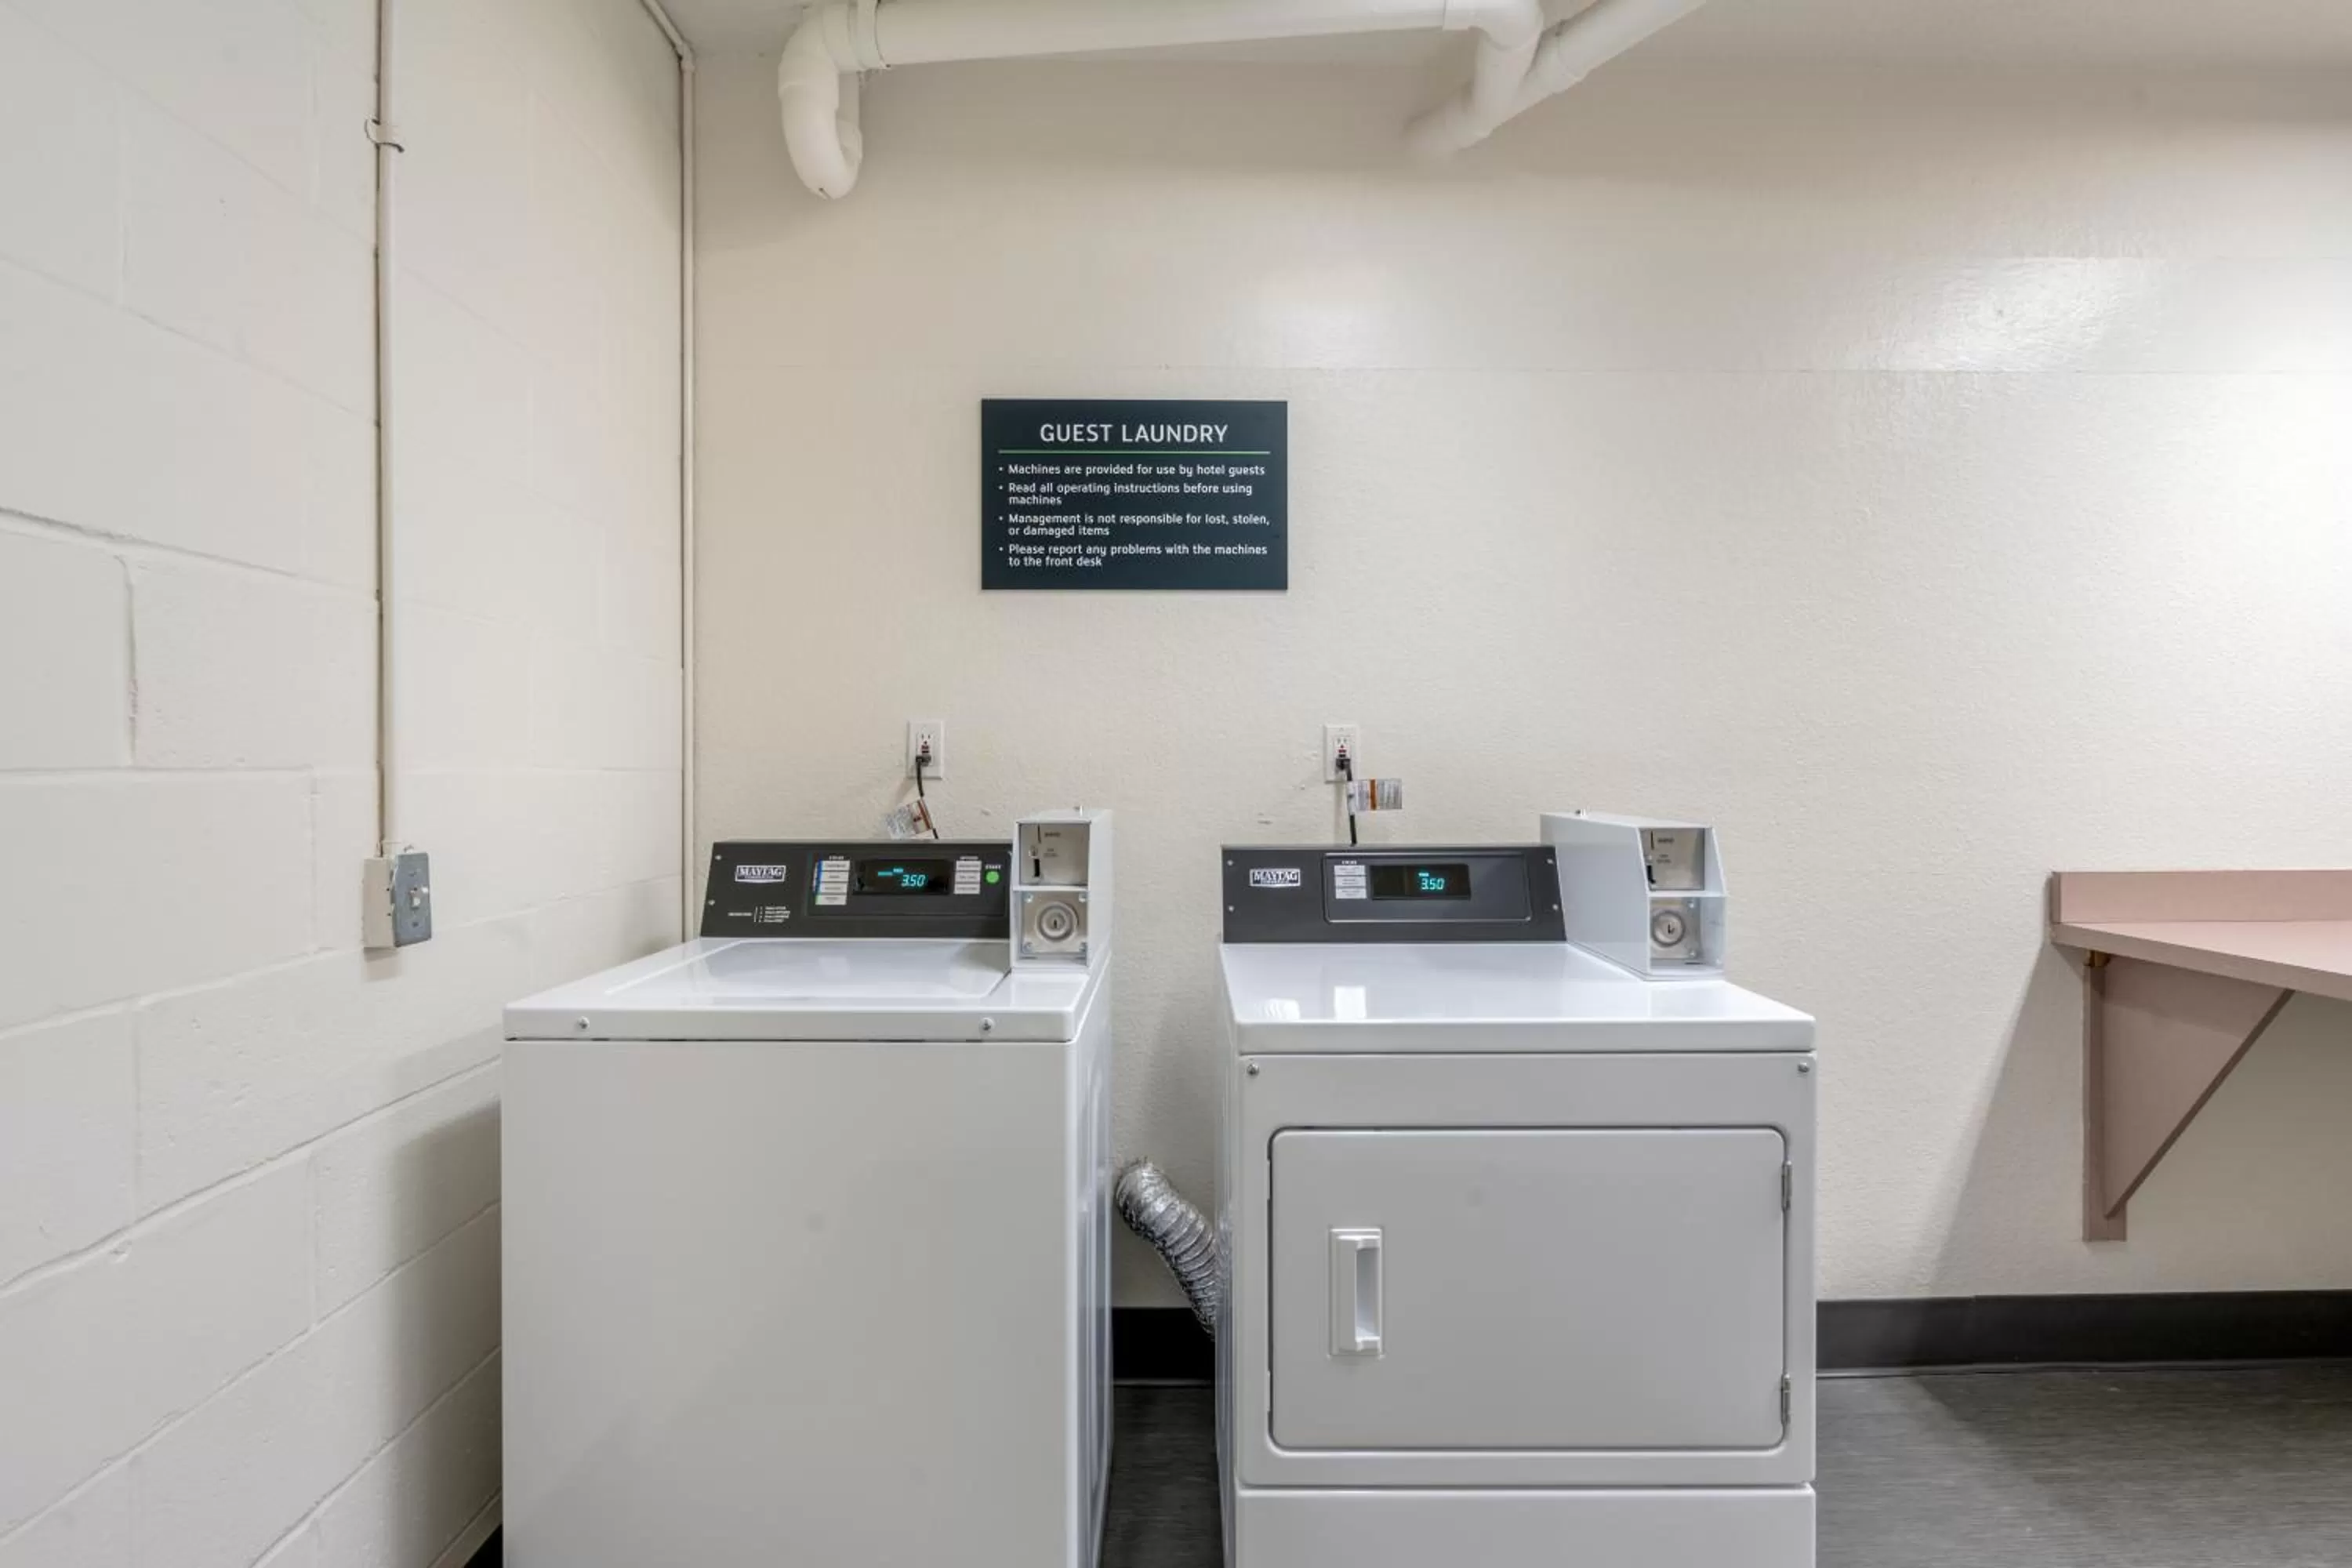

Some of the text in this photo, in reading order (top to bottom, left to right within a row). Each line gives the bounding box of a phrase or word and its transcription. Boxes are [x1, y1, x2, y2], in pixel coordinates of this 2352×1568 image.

[1040, 424, 1229, 443] GUEST LAUNDRY
[1009, 464, 1061, 474] Machines
[1086, 464, 1133, 477] provided
[1137, 464, 1152, 474] for
[1179, 465, 1193, 477] by
[1197, 465, 1225, 474] hotel
[1229, 466, 1265, 477] guests
[1009, 483, 1253, 495] Read all operating instructions before using
[1009, 495, 1062, 505] machines
[1009, 514, 1269, 526] Management is not responsible for lost, stolen,
[1023, 525, 1075, 538] damaged
[1078, 526, 1110, 535] items
[1009, 544, 1268, 557] Please report any problems with the machines
[1008, 556, 1104, 567] to the front desk
[739, 867, 782, 876] MAYTAG
[1254, 870, 1298, 880] MAYTAG
